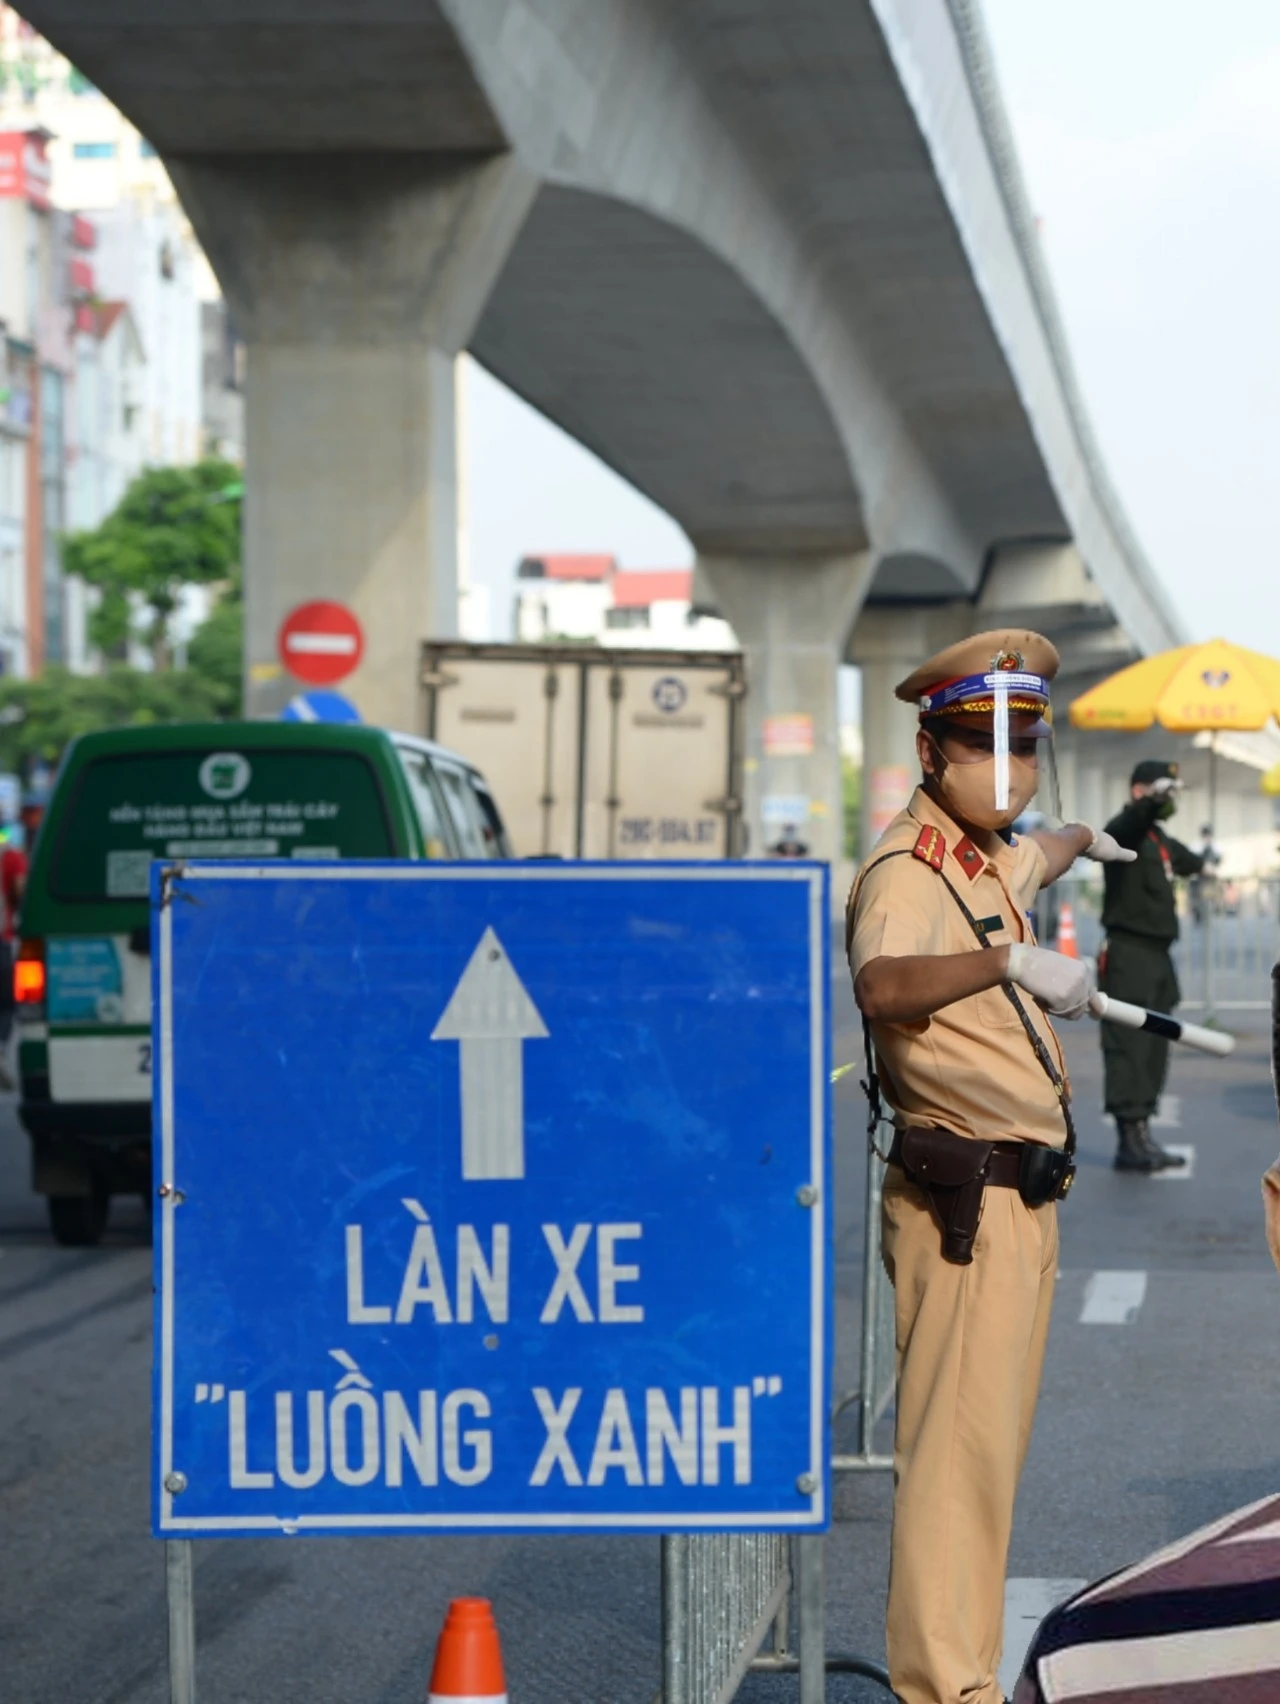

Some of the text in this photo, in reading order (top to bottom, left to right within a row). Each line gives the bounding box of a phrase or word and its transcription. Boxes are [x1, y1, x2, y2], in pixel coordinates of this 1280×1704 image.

[344, 1197, 644, 1325] LÀN XE
[195, 1349, 783, 1489] "LUỒNG XANH"
